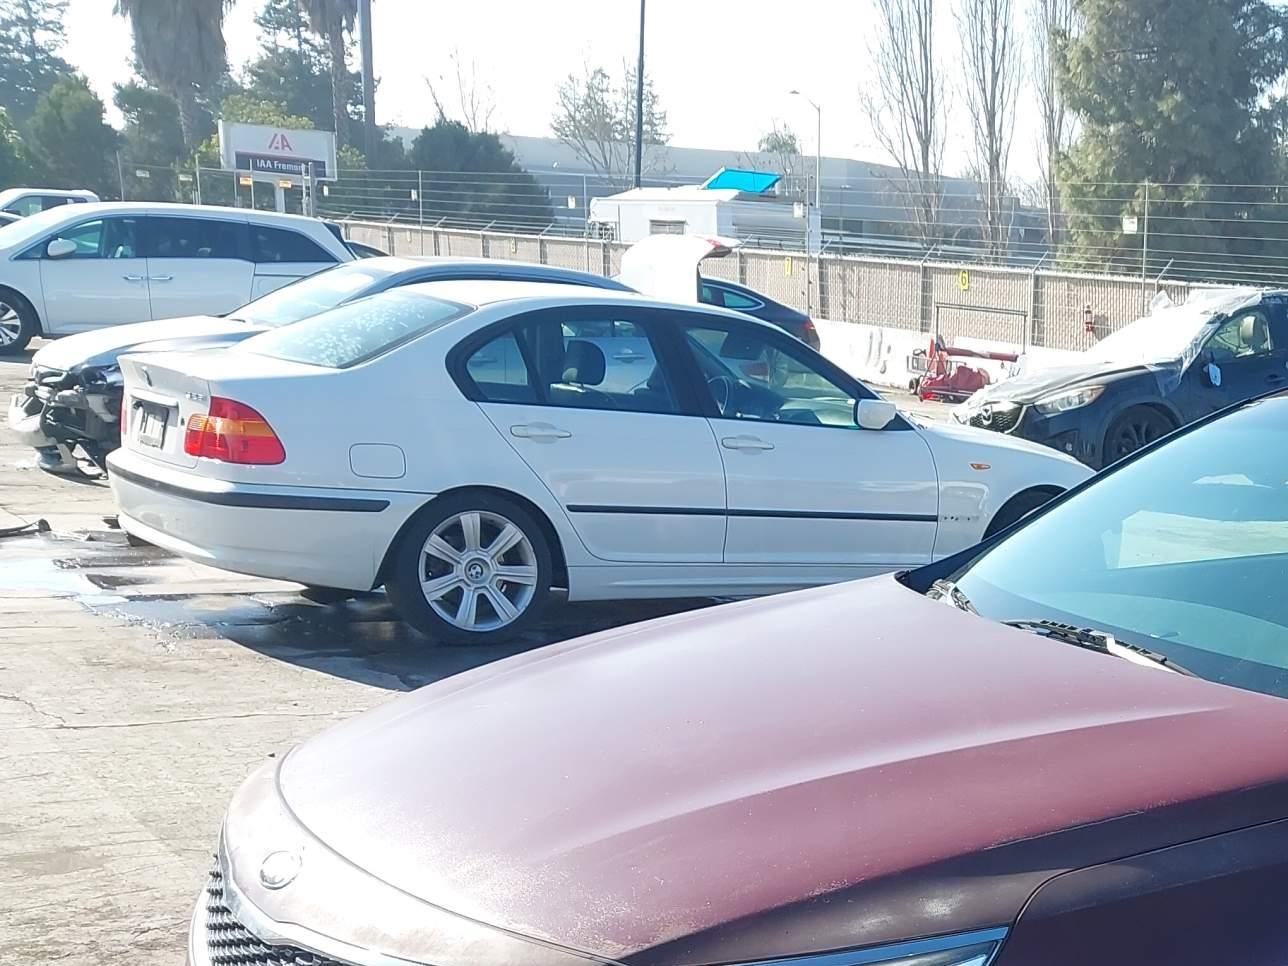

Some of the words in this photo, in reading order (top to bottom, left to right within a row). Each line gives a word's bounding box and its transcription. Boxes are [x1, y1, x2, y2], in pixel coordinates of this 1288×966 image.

[256, 159, 272, 168] IAA
[274, 160, 305, 172] Fremon
[961, 270, 967, 286] 6
